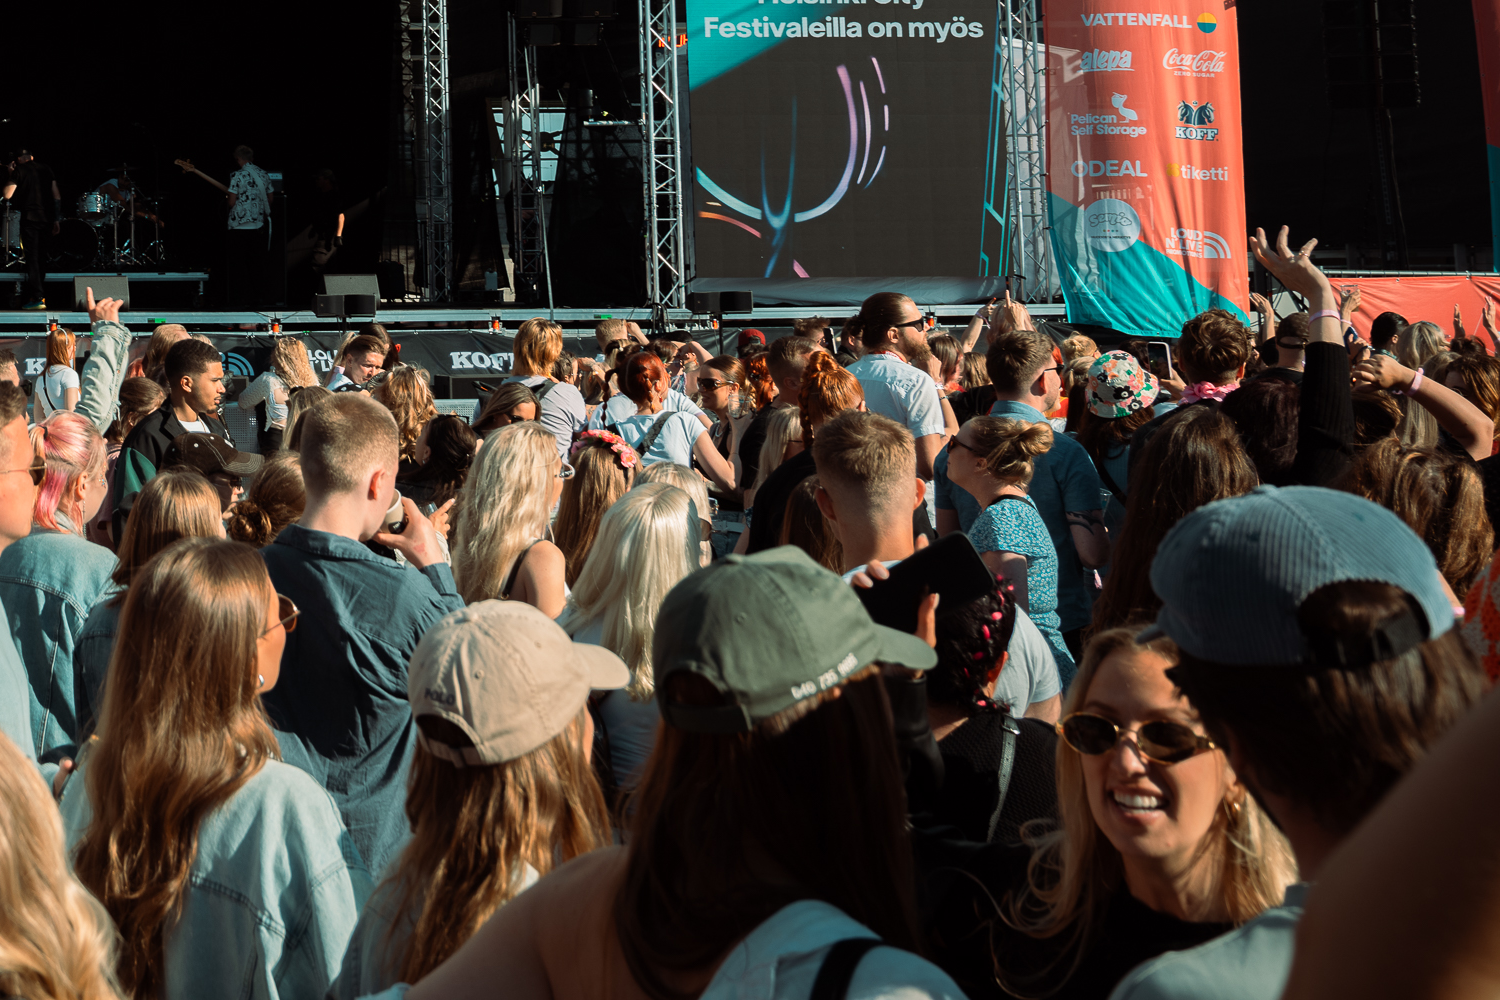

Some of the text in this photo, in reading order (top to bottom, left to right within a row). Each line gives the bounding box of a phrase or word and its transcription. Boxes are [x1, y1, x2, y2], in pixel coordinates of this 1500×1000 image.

[1081, 12, 1192, 29] VATTENFALL
[704, 16, 984, 43] Festivaleilla on myös
[1079, 48, 1132, 72] alepa
[1162, 48, 1227, 73] Coca-Cola
[1070, 113, 1117, 124] Pelican
[1070, 124, 1147, 138] Self Storage
[1175, 126, 1218, 141] KOFF
[1070, 160, 1148, 177] ODEAL
[1181, 164, 1229, 181] tiketti
[1170, 227, 1202, 241] LOUD
[1165, 248, 1202, 259] PROMOTIONS
